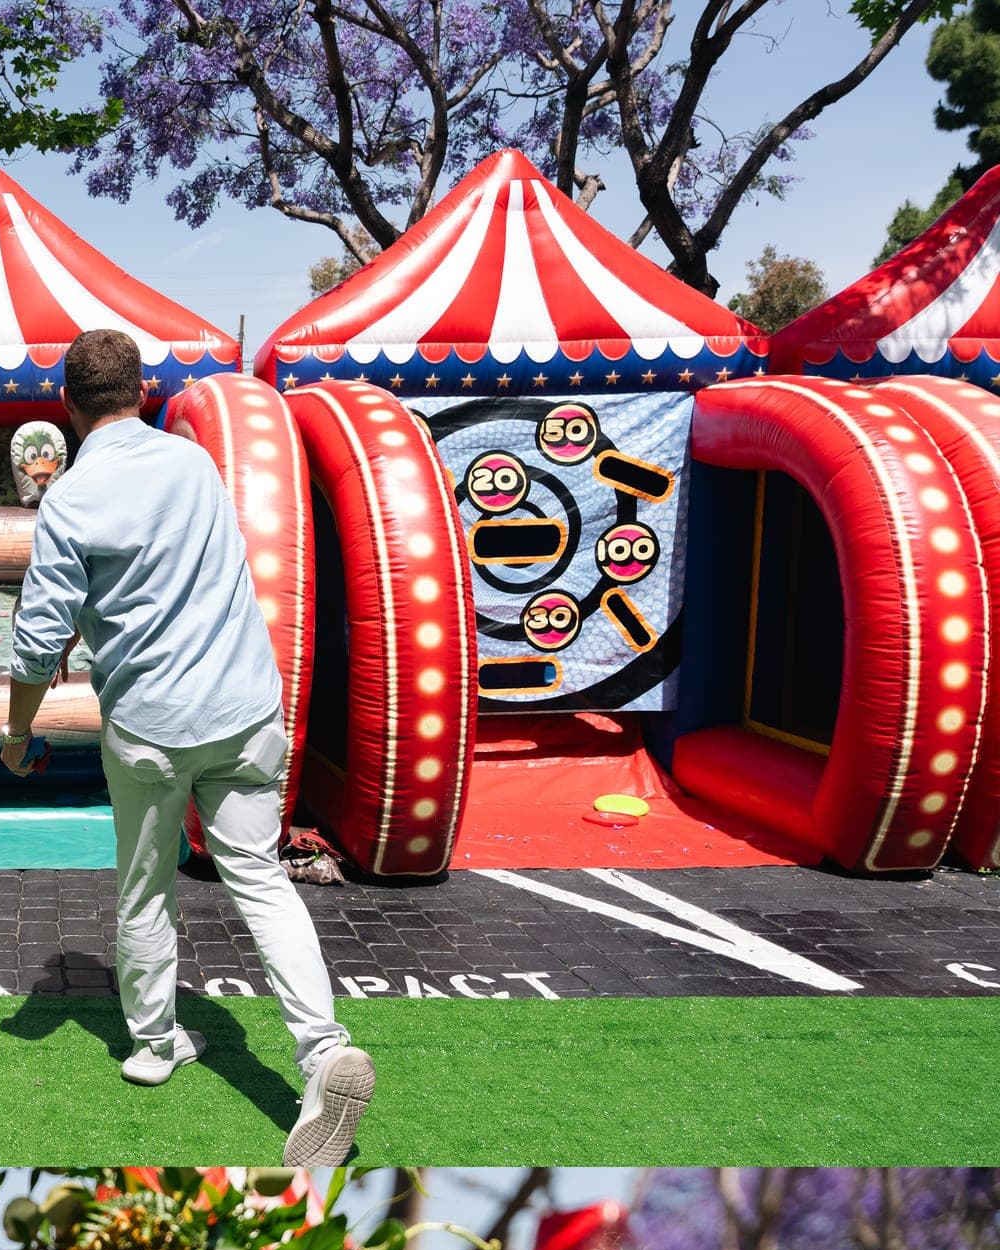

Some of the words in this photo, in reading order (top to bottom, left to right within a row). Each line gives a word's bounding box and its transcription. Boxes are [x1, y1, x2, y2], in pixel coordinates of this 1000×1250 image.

[543, 418, 589, 443] 50
[472, 468, 518, 492] 20
[598, 537, 655, 562] 100
[527, 607, 572, 630] 30
